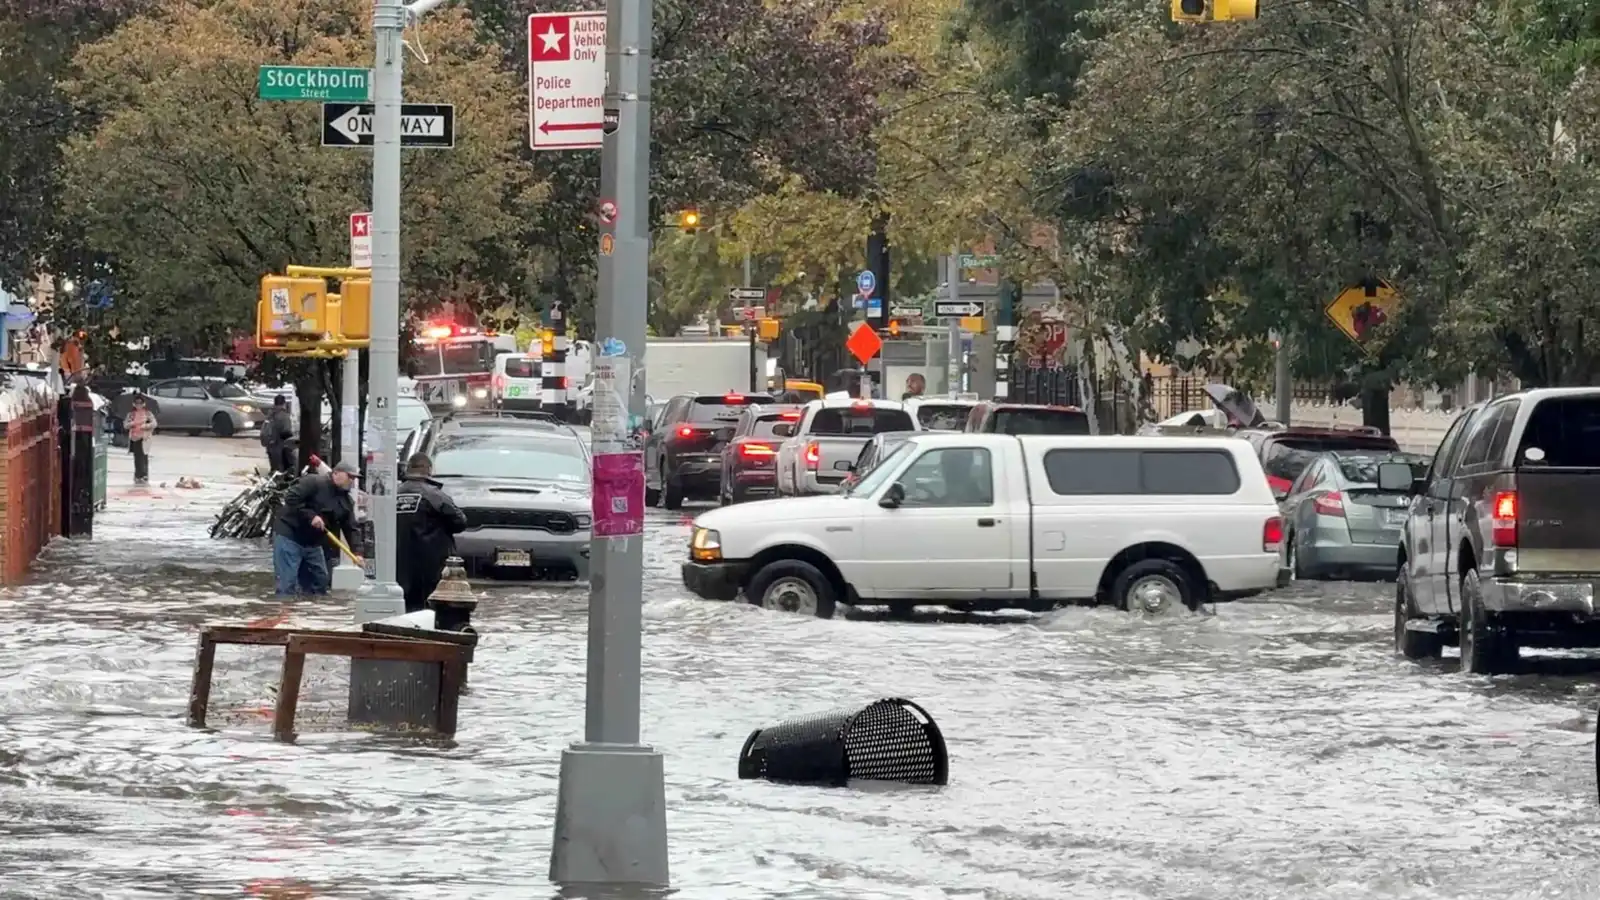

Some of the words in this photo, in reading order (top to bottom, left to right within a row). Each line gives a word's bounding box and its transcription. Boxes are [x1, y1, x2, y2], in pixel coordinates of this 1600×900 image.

[574, 20, 606, 32] Autho
[574, 34, 607, 47] Vehicl
[574, 49, 598, 63] Only
[266, 69, 365, 88] Stockholm
[536, 76, 571, 90] Police
[301, 89, 330, 98] Street
[347, 116, 373, 133] ON
[401, 117, 436, 134] WAY
[1044, 324, 1065, 342] OP
